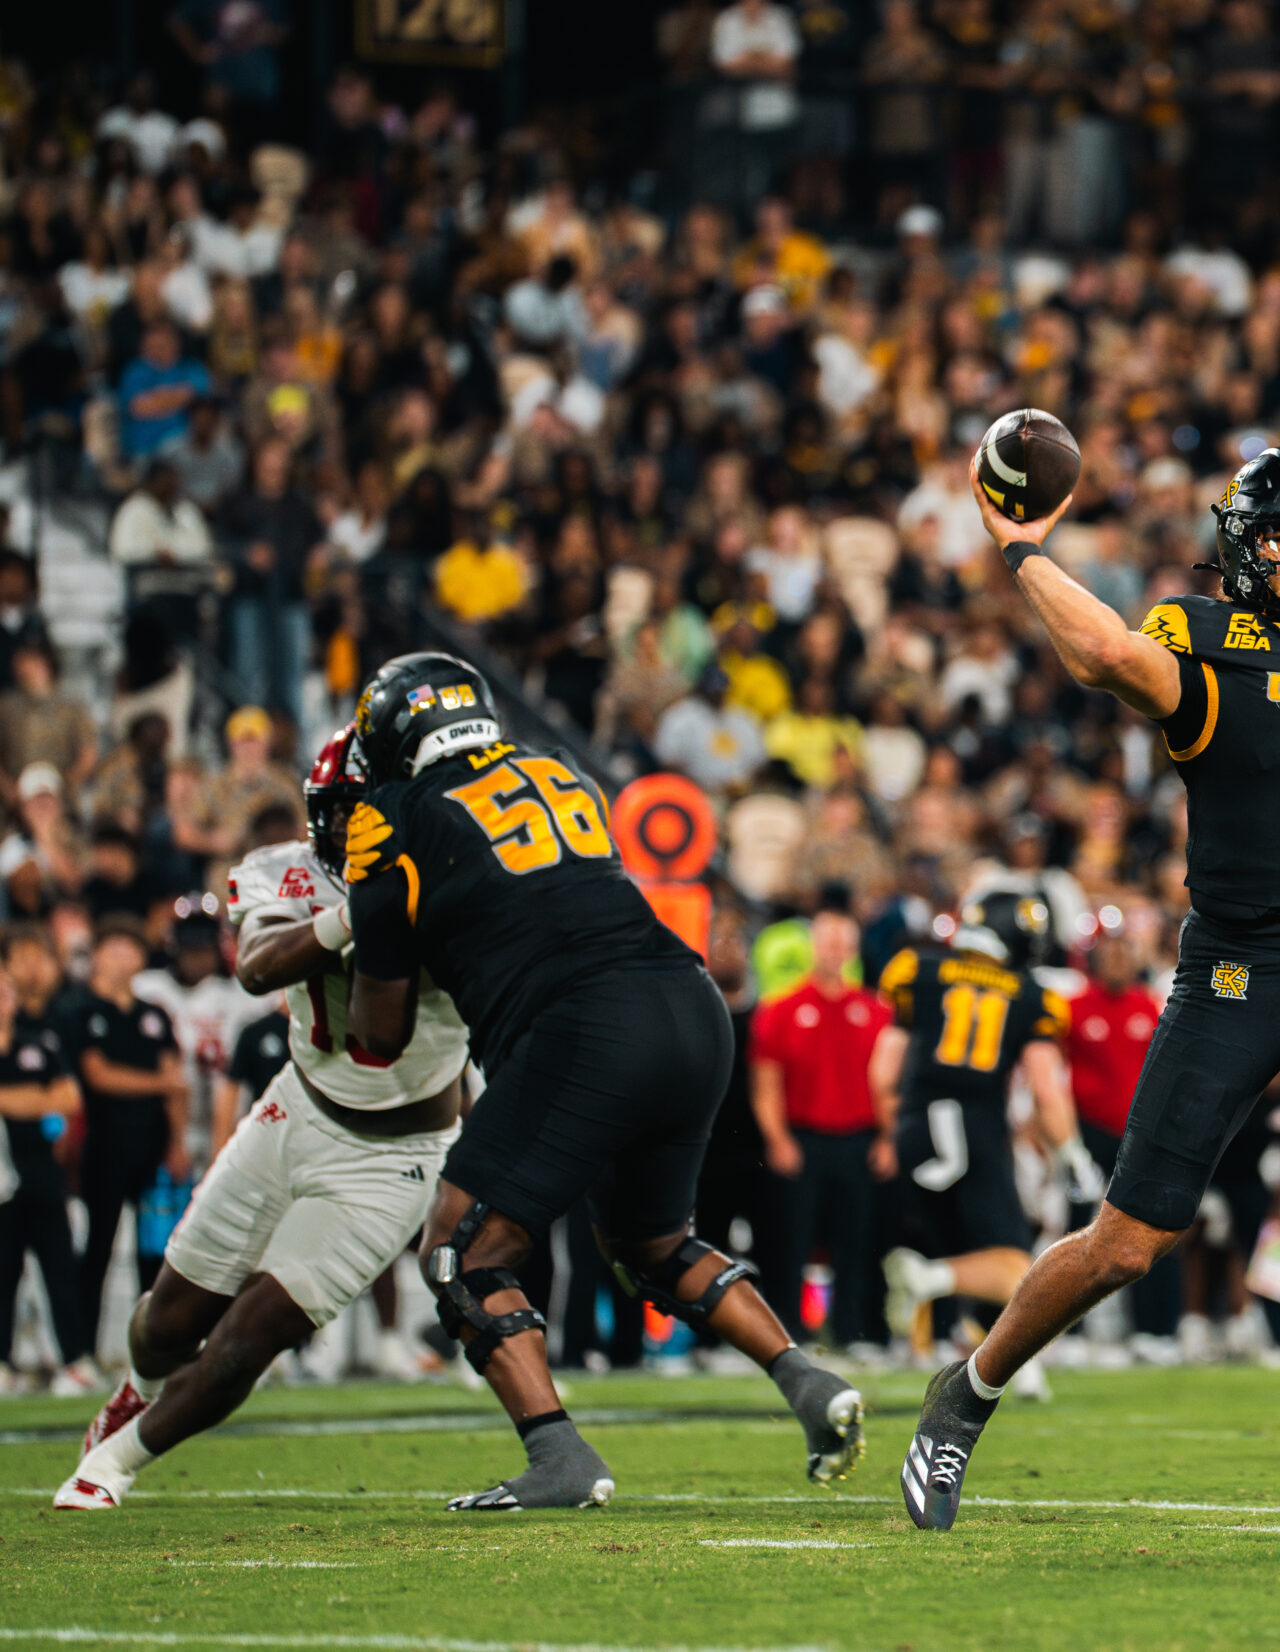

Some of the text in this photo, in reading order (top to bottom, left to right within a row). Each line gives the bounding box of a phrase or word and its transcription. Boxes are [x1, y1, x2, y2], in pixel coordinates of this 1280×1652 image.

[1223, 632, 1271, 651] USA
[449, 723, 483, 739] OWLS
[442, 756, 612, 876] 56
[278, 884, 315, 899] USA
[936, 983, 1010, 1072] 11
